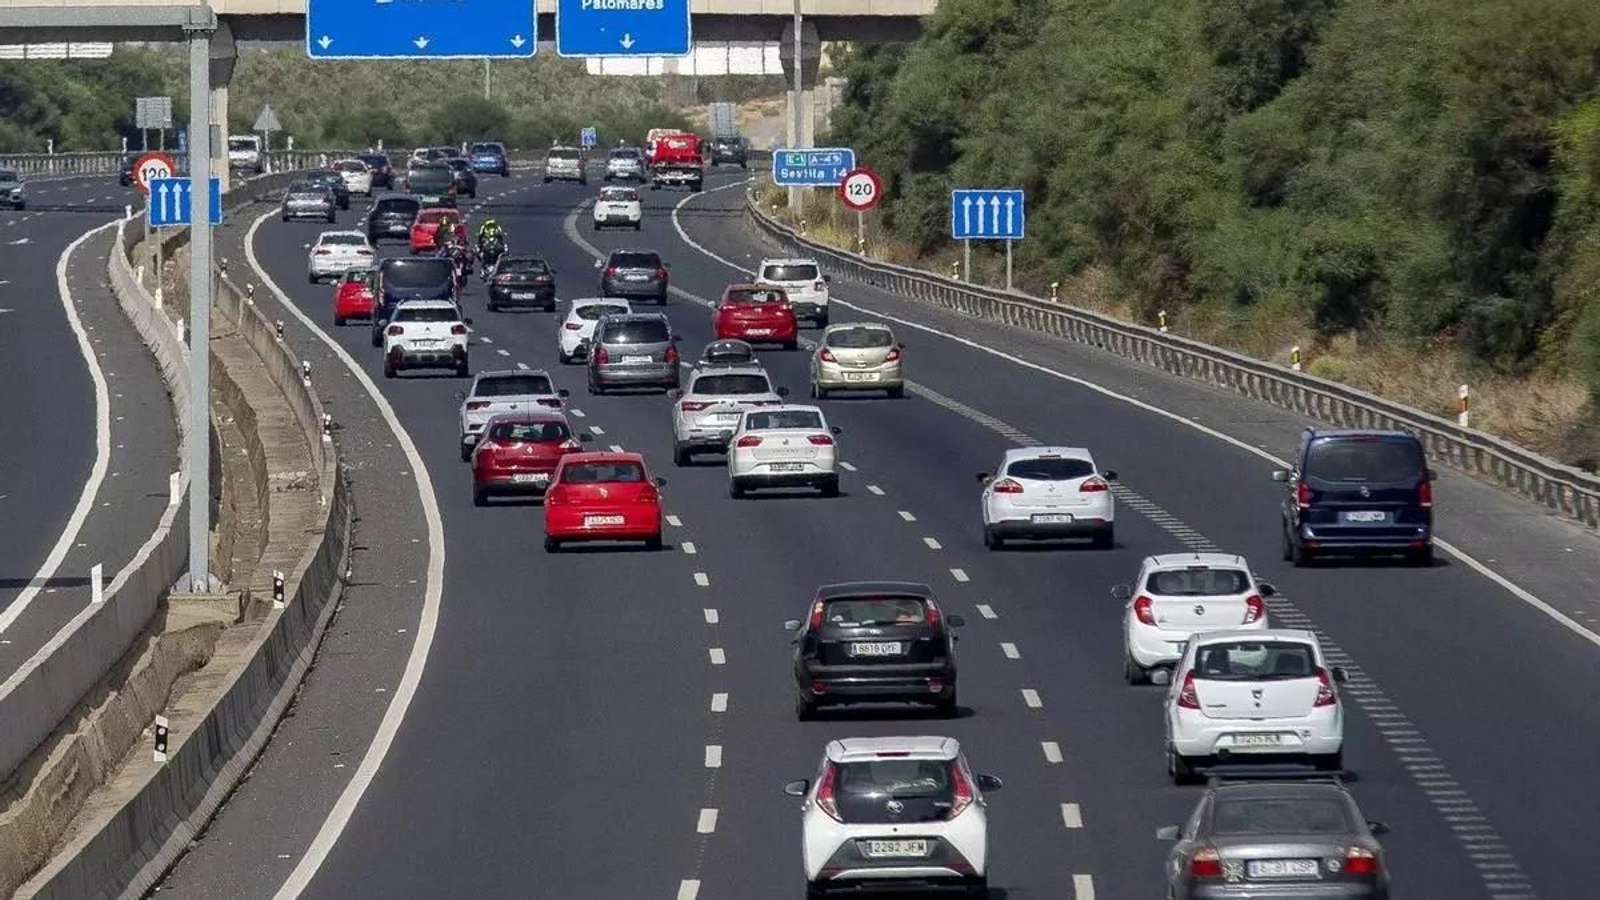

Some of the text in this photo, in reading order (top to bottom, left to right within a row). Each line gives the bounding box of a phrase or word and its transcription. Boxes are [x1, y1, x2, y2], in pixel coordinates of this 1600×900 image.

[582, 0, 664, 10] Palomares
[811, 155, 840, 164] A-49
[780, 168, 825, 179] Sevilla
[848, 183, 873, 195] 120
[874, 842, 901, 853] 2292
